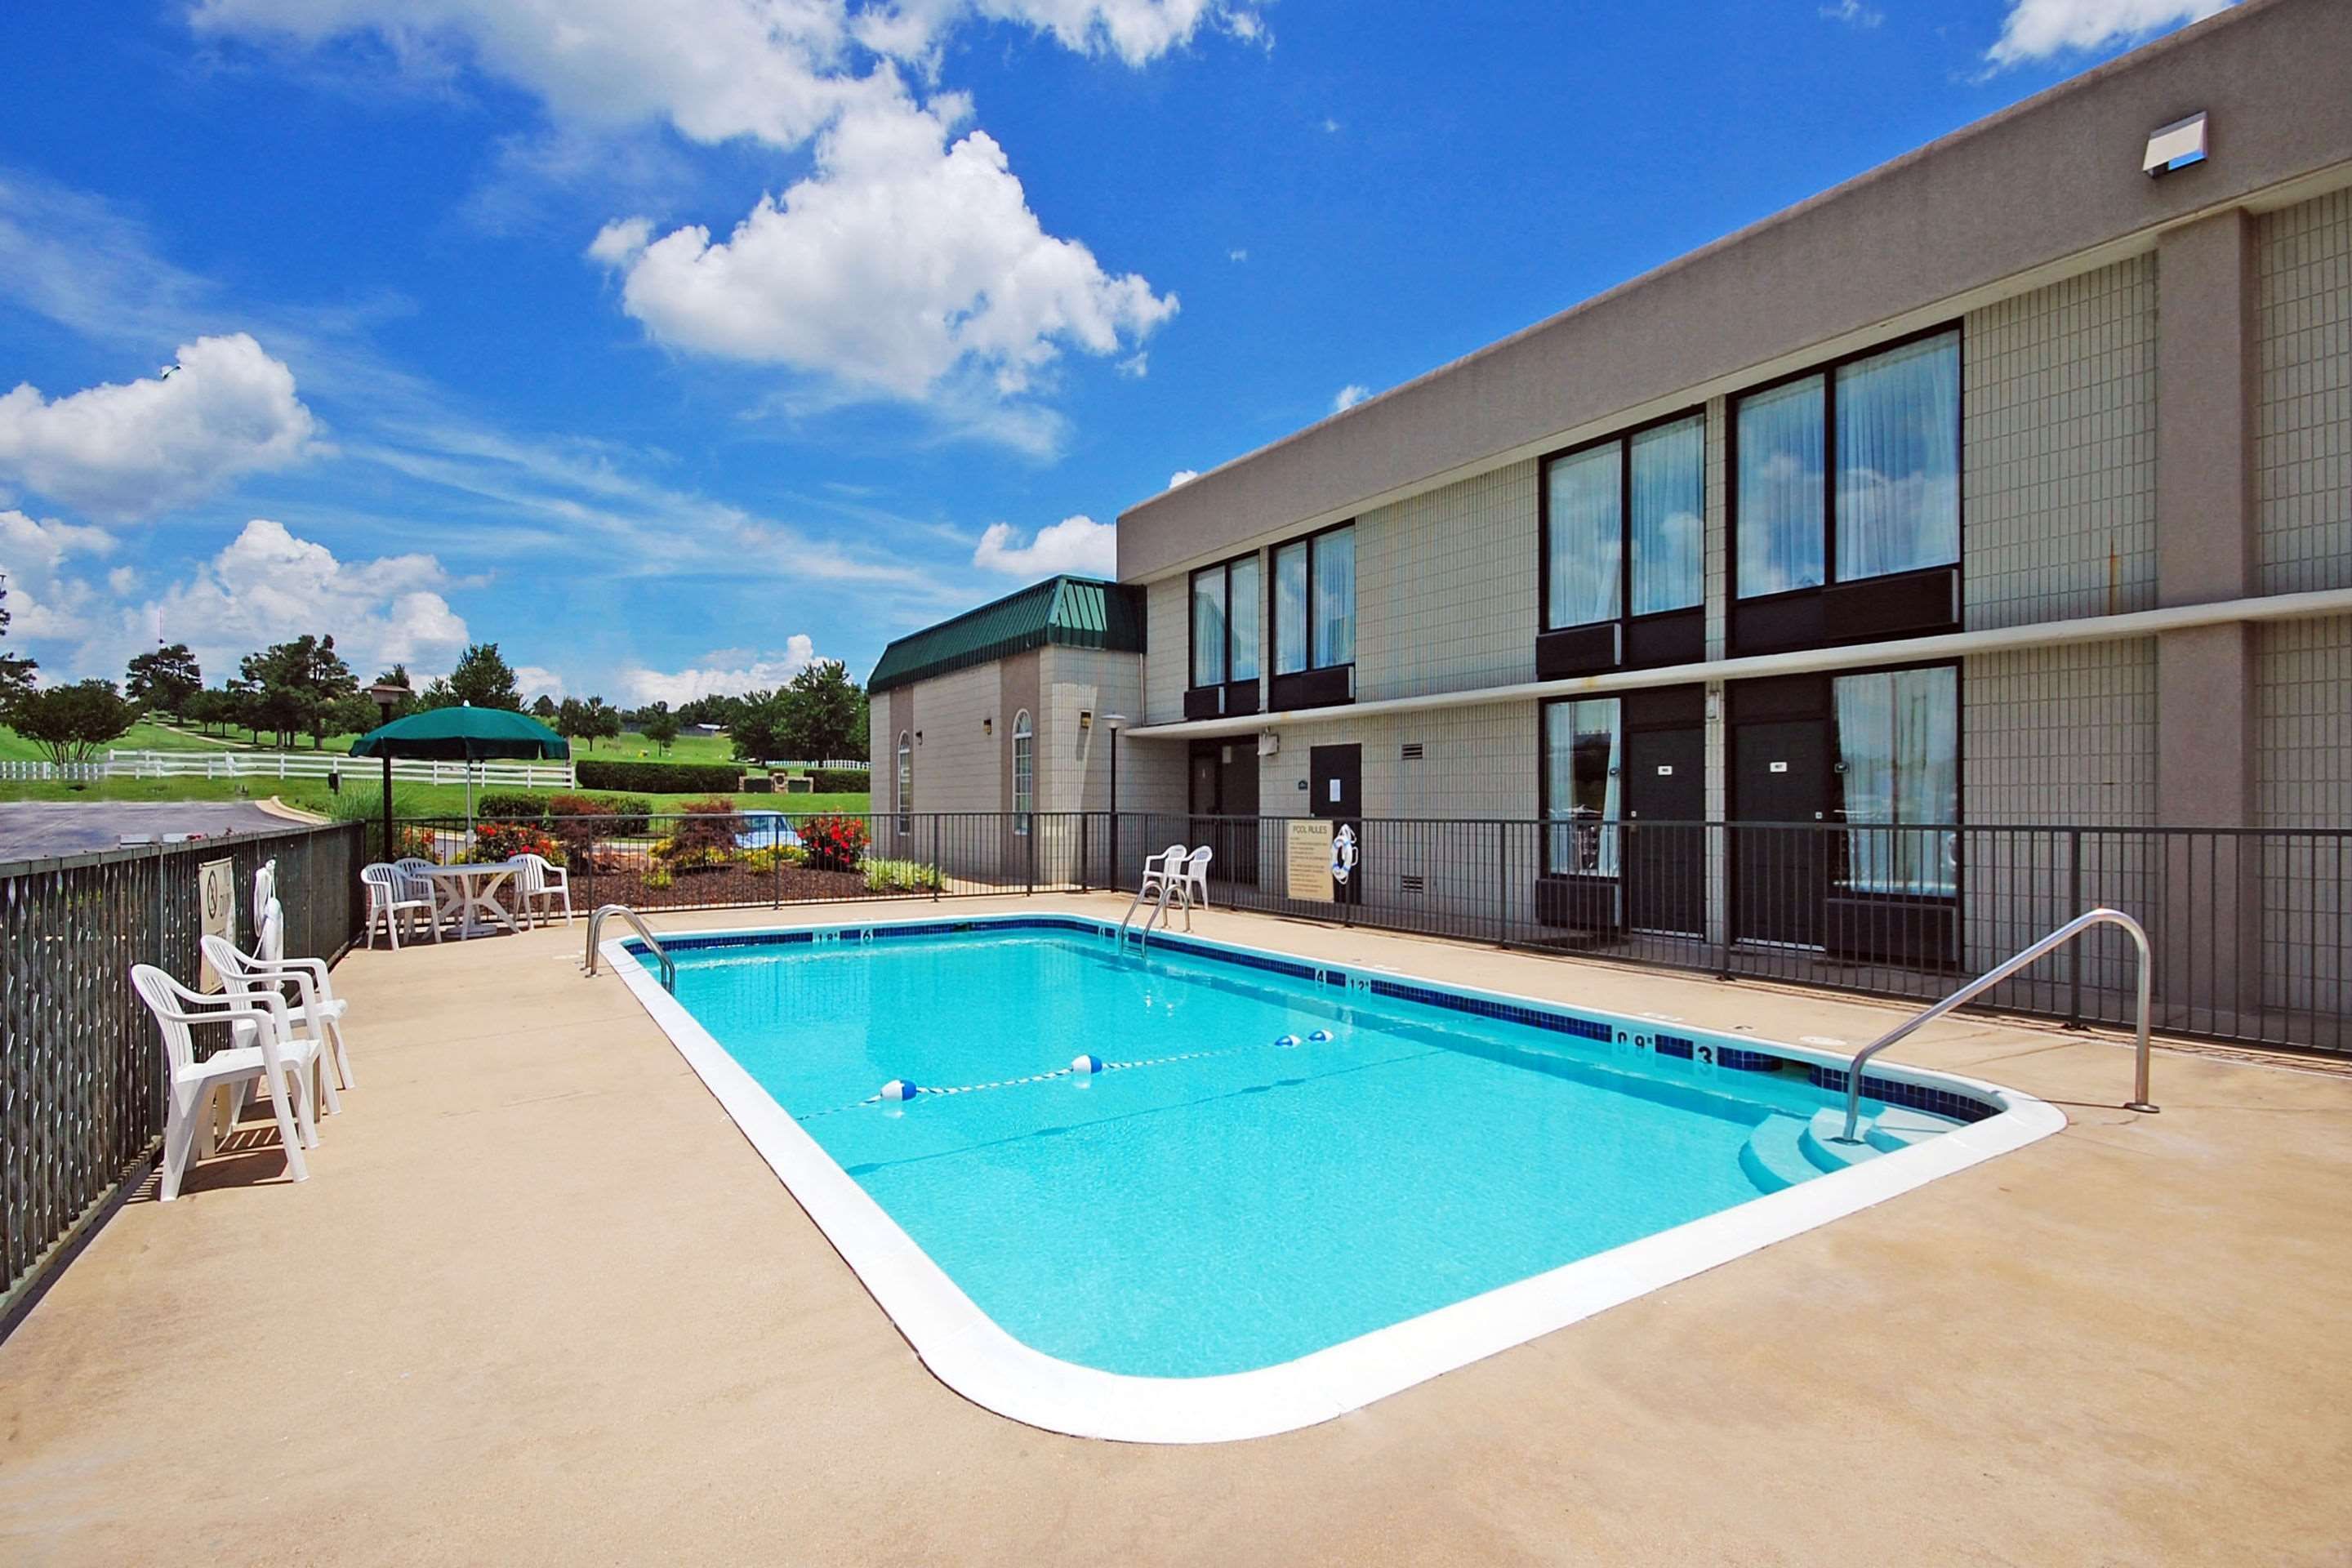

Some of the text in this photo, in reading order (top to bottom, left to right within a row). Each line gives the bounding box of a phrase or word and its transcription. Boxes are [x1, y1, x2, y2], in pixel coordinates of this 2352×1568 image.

[1293, 825, 1328, 834] POOL RULES
[1316, 969, 1325, 983] 4
